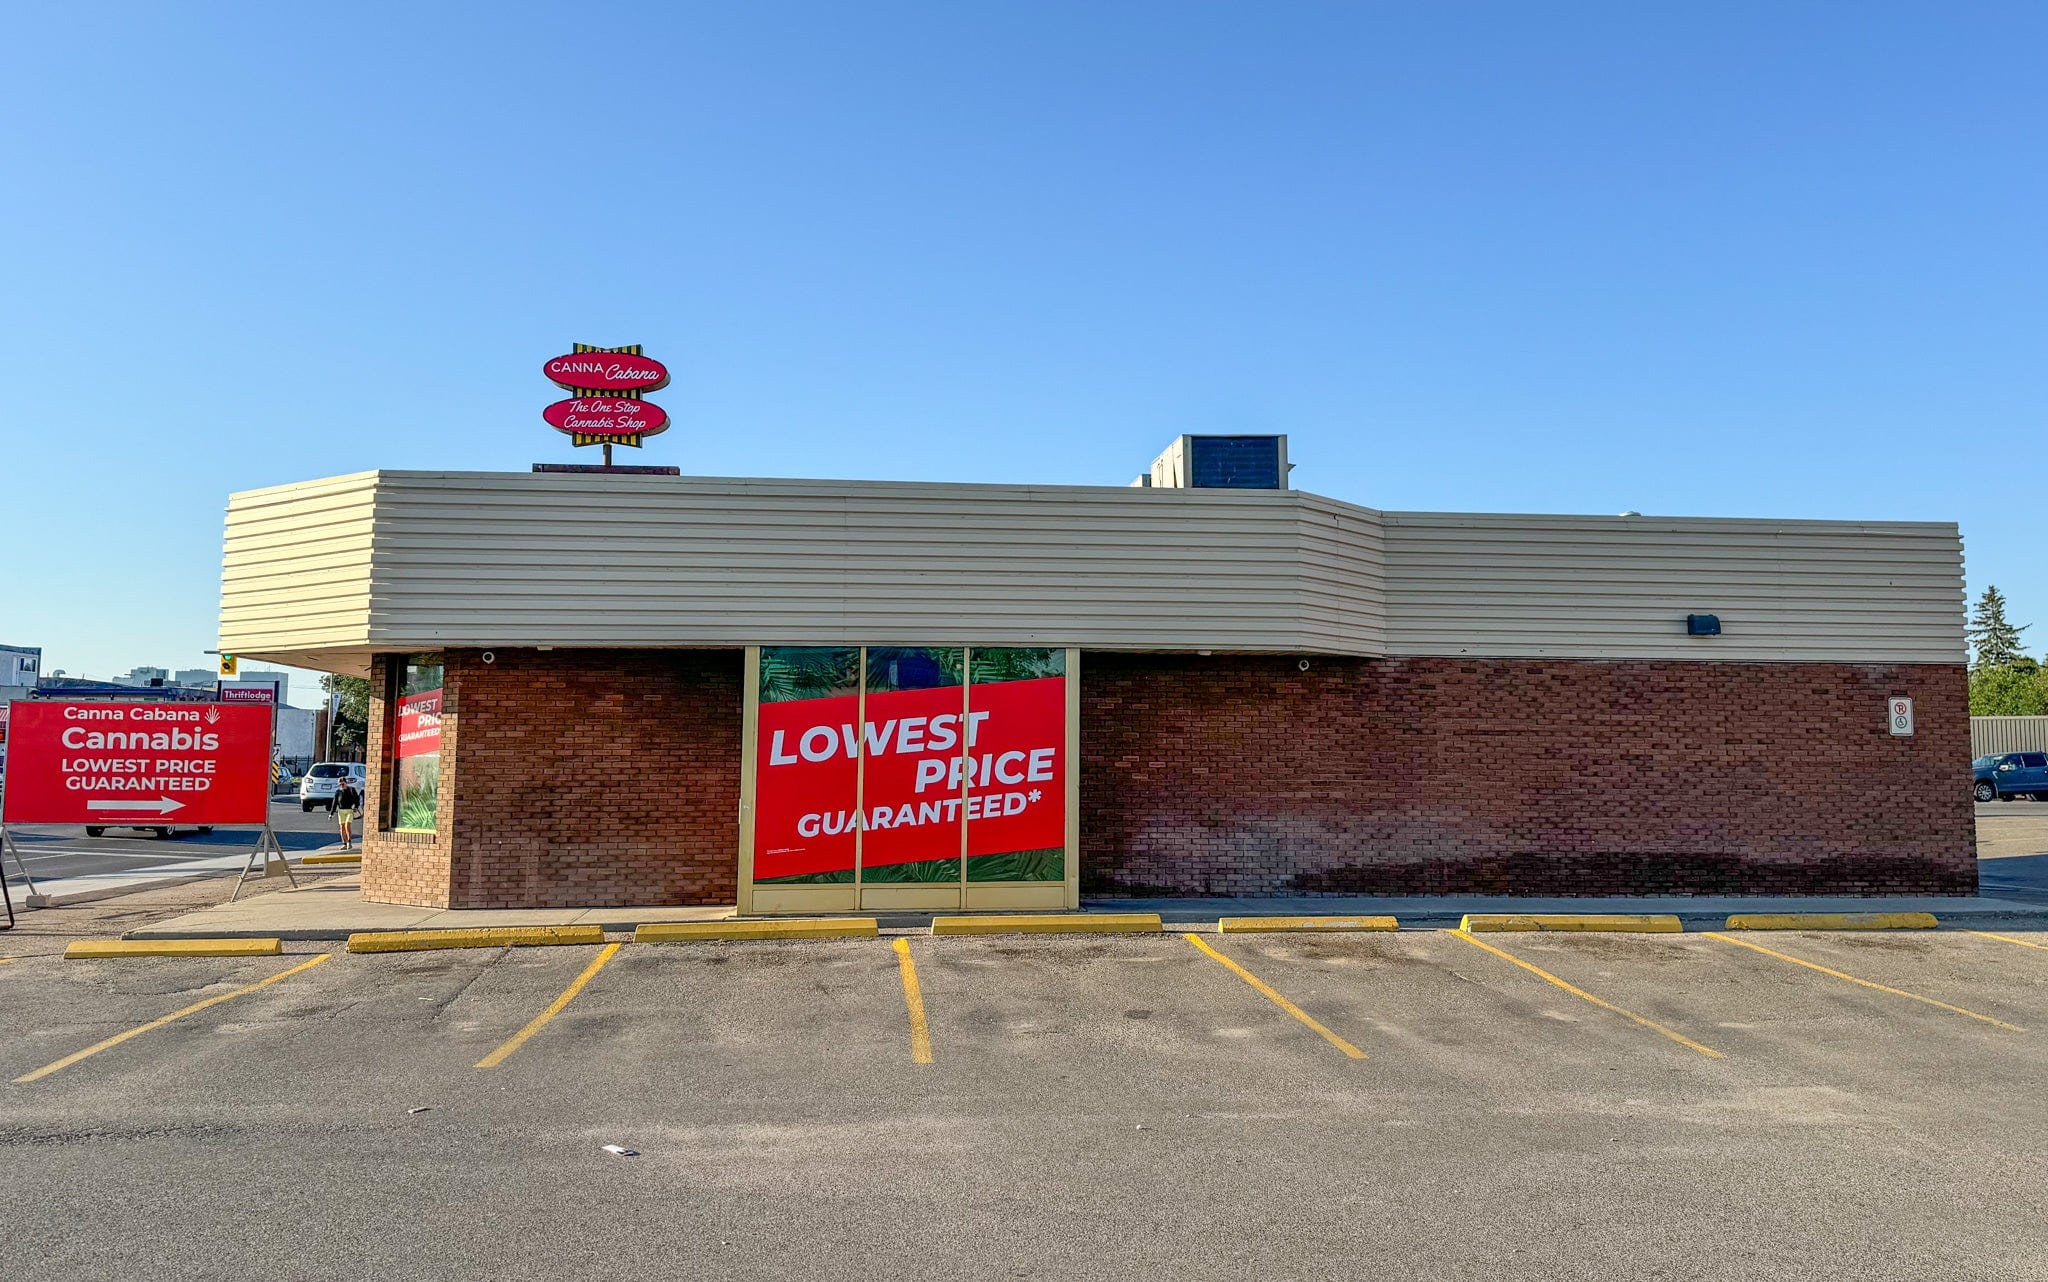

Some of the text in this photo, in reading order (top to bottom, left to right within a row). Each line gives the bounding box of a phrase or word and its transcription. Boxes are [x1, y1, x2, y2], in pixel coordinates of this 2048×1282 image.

[551, 362, 660, 380] CANNA Cabana
[570, 400, 640, 415] The One Stop
[563, 415, 646, 430] Cannabis Shop
[224, 690, 272, 701] Thriftlodge
[63, 706, 200, 721] Canna Cabana
[398, 698, 438, 717] LOWEST
[417, 711, 442, 729] PRIC
[61, 726, 219, 750] Cannabis
[769, 711, 990, 766] LOWEST
[62, 758, 216, 774] LOWEST PRICE
[914, 747, 1056, 794] PRICE
